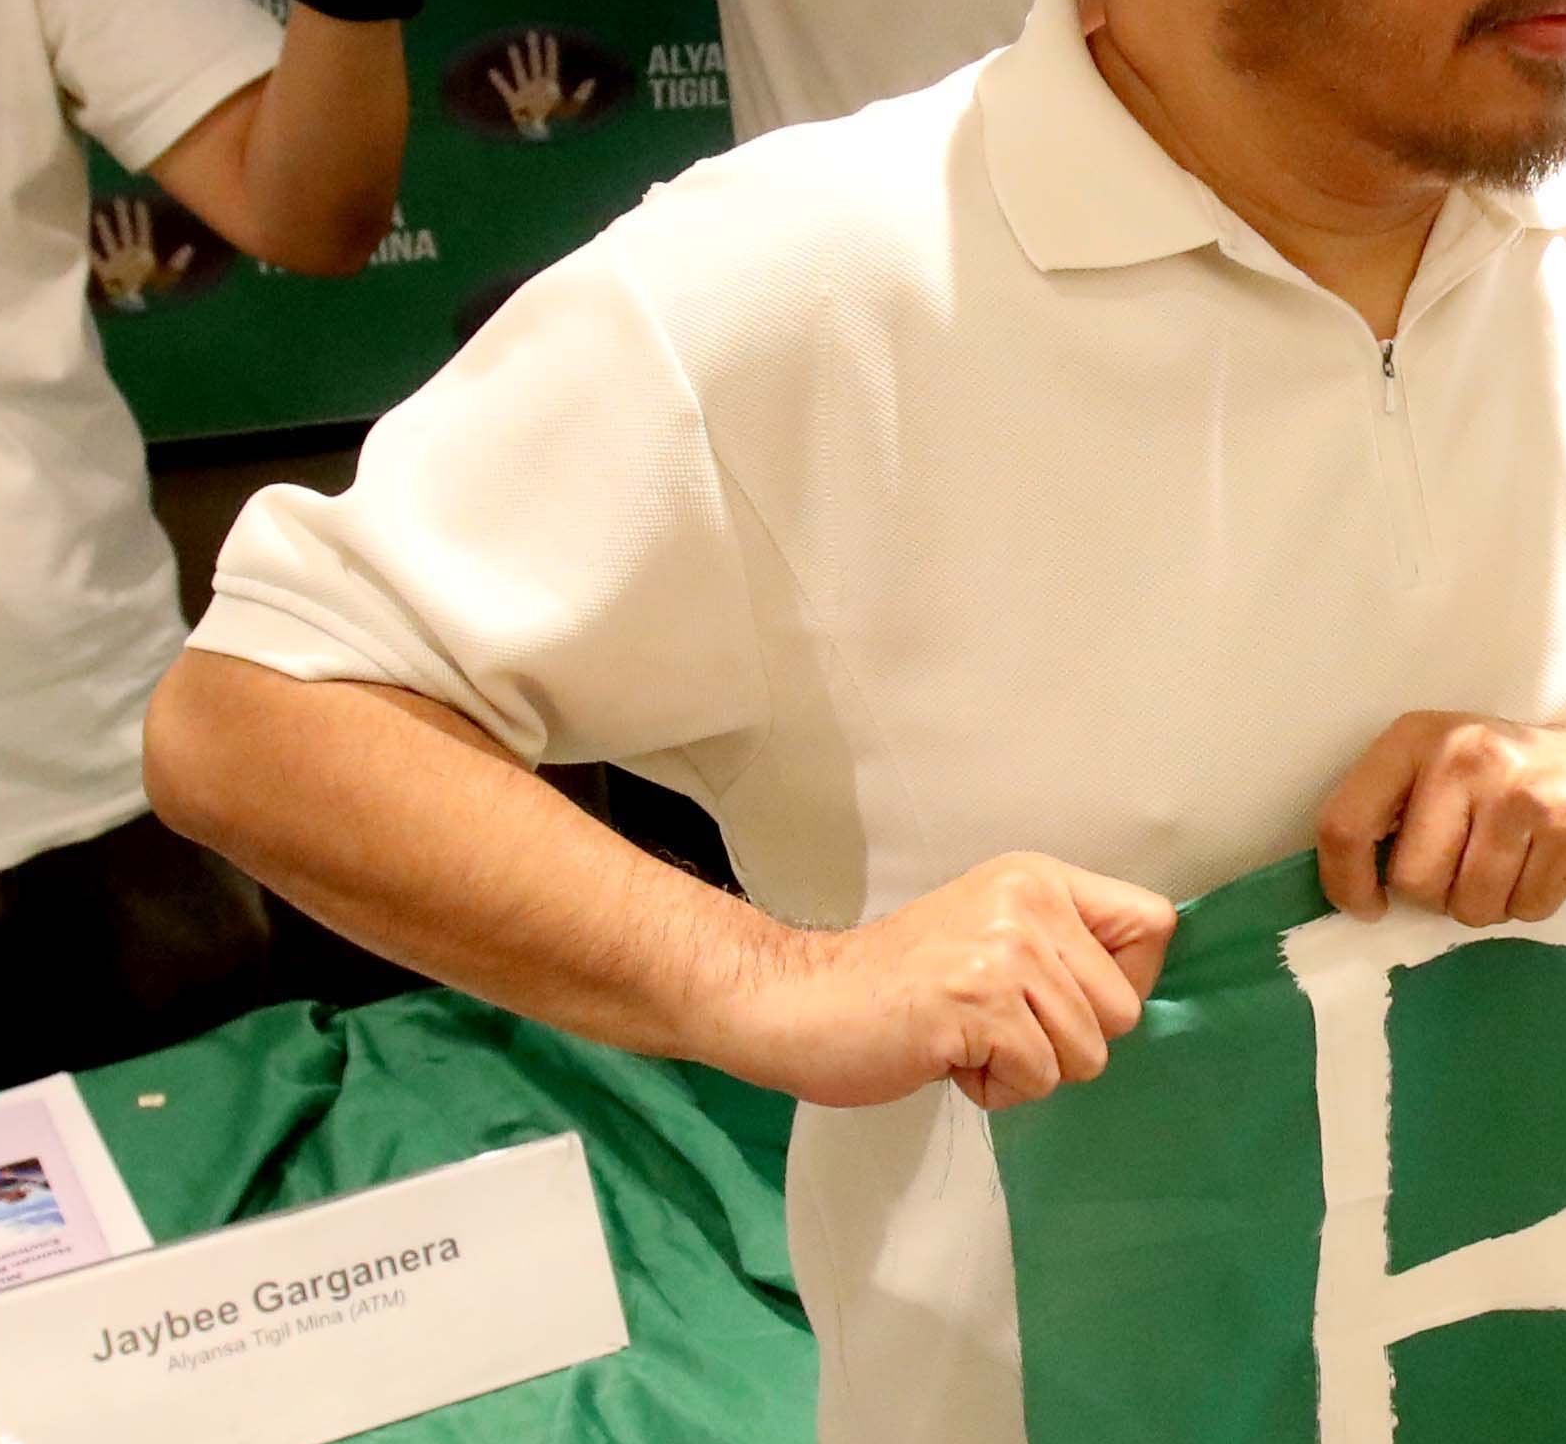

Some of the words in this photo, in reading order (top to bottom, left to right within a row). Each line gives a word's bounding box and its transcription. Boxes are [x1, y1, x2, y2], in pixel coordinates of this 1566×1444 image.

[94, 1299, 240, 1362] Jaybee
[253, 1235, 461, 1314] Garganera
[168, 1337, 247, 1372] Alyansa
[252, 1320, 293, 1348] Tigil
[296, 1308, 343, 1335] Mina
[349, 1289, 406, 1325] (ATM)
